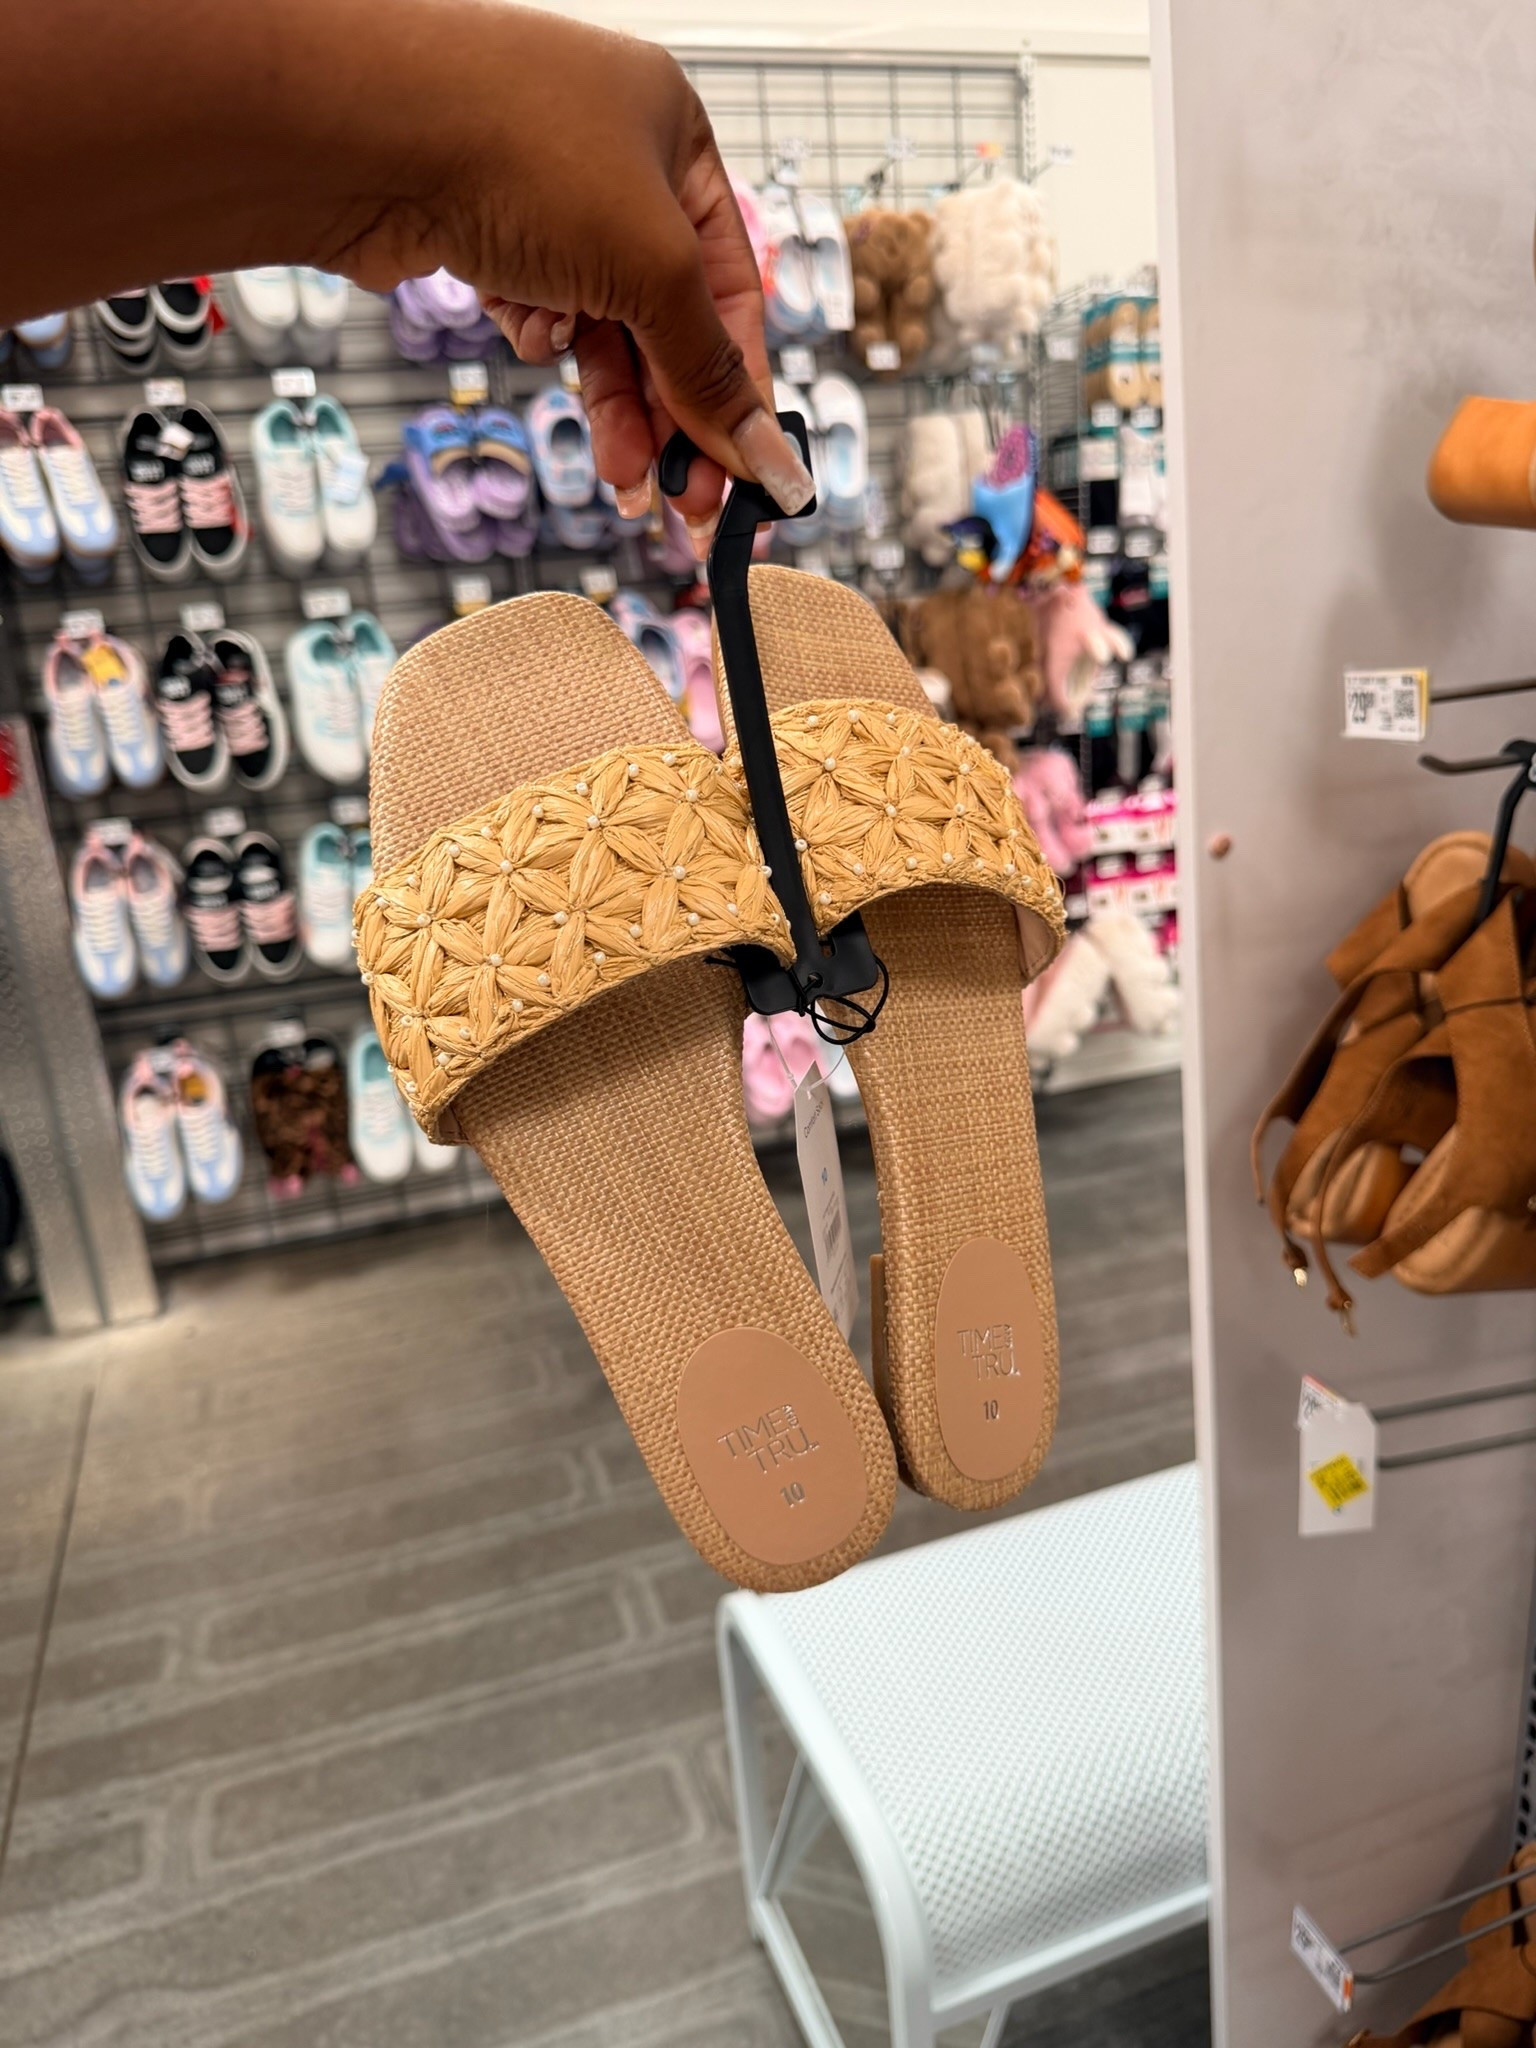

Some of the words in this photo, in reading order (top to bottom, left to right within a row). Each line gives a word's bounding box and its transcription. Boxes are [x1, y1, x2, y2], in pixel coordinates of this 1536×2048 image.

[957, 1325, 1004, 1356] TIME
[972, 1351, 1015, 1381] TRU
[983, 1399, 1000, 1421] 10
[717, 1407, 790, 1459] TIME
[747, 1428, 811, 1474] TRU
[780, 1482, 806, 1508] 10
